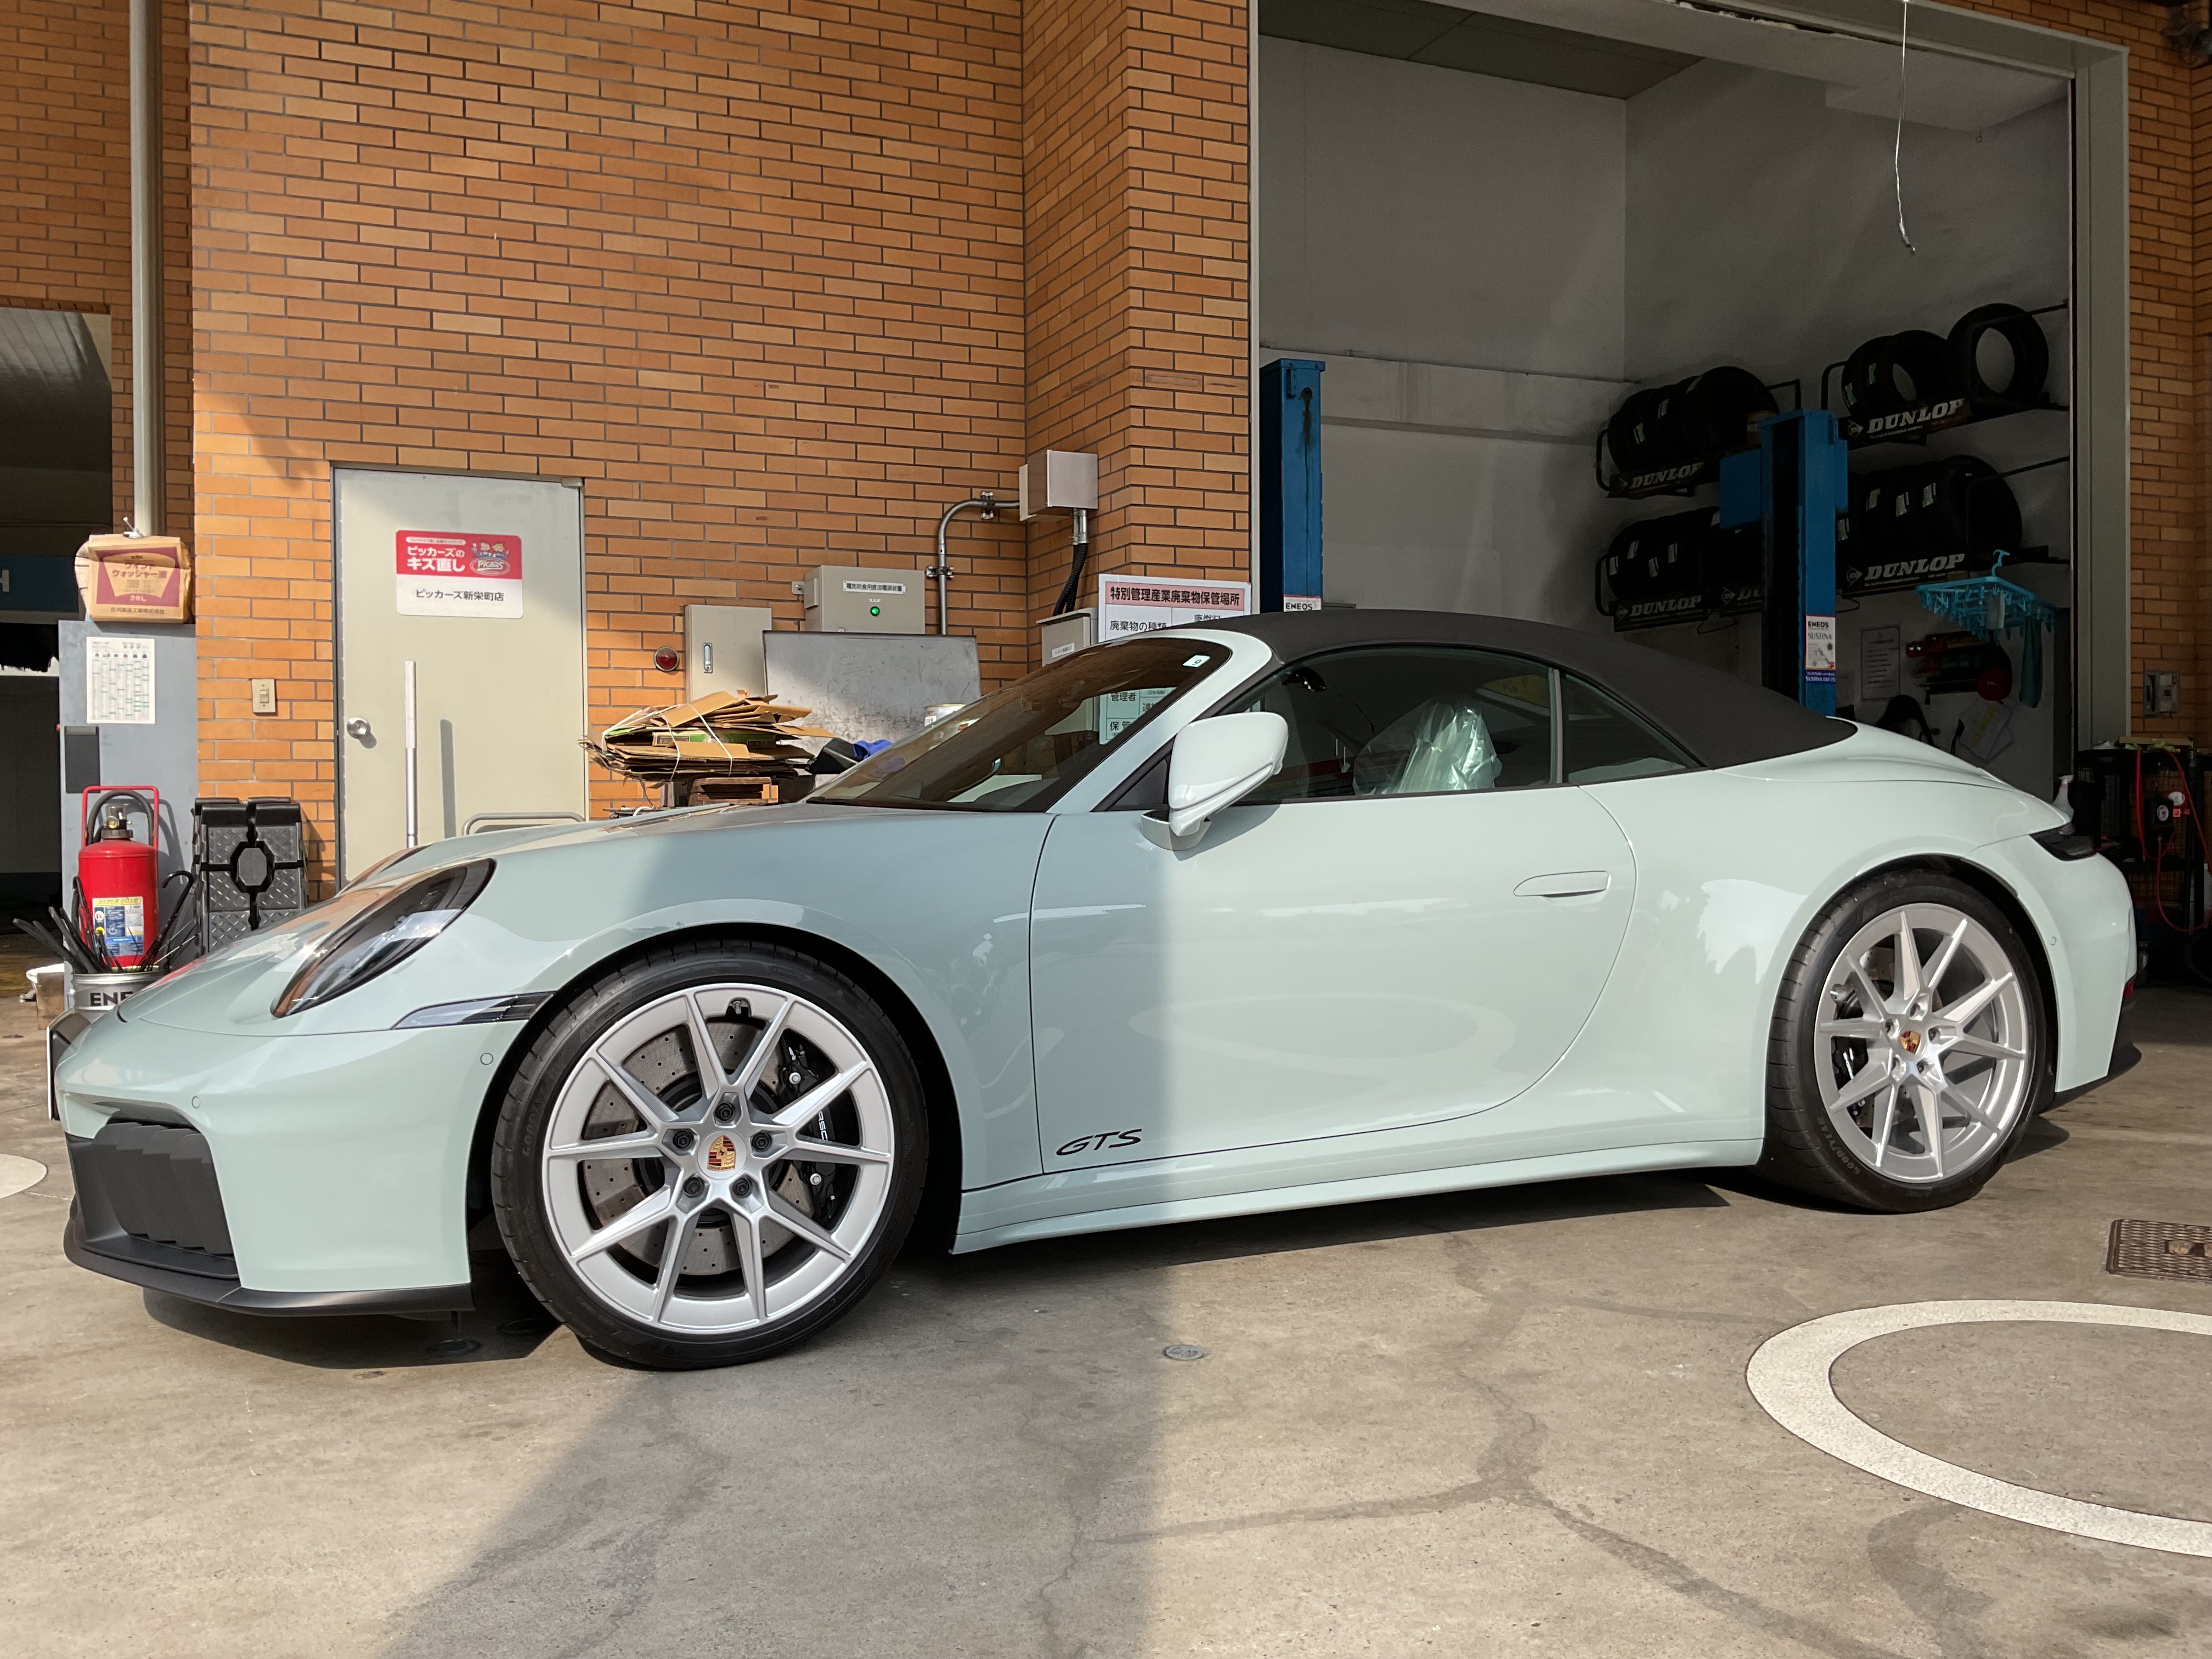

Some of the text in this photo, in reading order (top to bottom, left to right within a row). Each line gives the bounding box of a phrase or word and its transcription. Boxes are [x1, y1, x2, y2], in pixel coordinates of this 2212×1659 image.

[1866, 398, 1965, 433] DUNLOP
[1629, 462, 1704, 489] DUNLOP
[407, 546, 465, 558] ピッカーズの
[407, 557, 466, 572] キズ直し
[1864, 553, 1965, 581] DUNLOP
[416, 589, 504, 601] ピッカーズ新栄町店
[1110, 586, 1240, 606] 特別管理産業廃棄物保管場所
[1285, 602, 1313, 611] ENEOS
[1629, 595, 1702, 617] DUNLOP
[1111, 692, 1136, 702] 管理者
[1056, 1128, 1142, 1156] GTS
